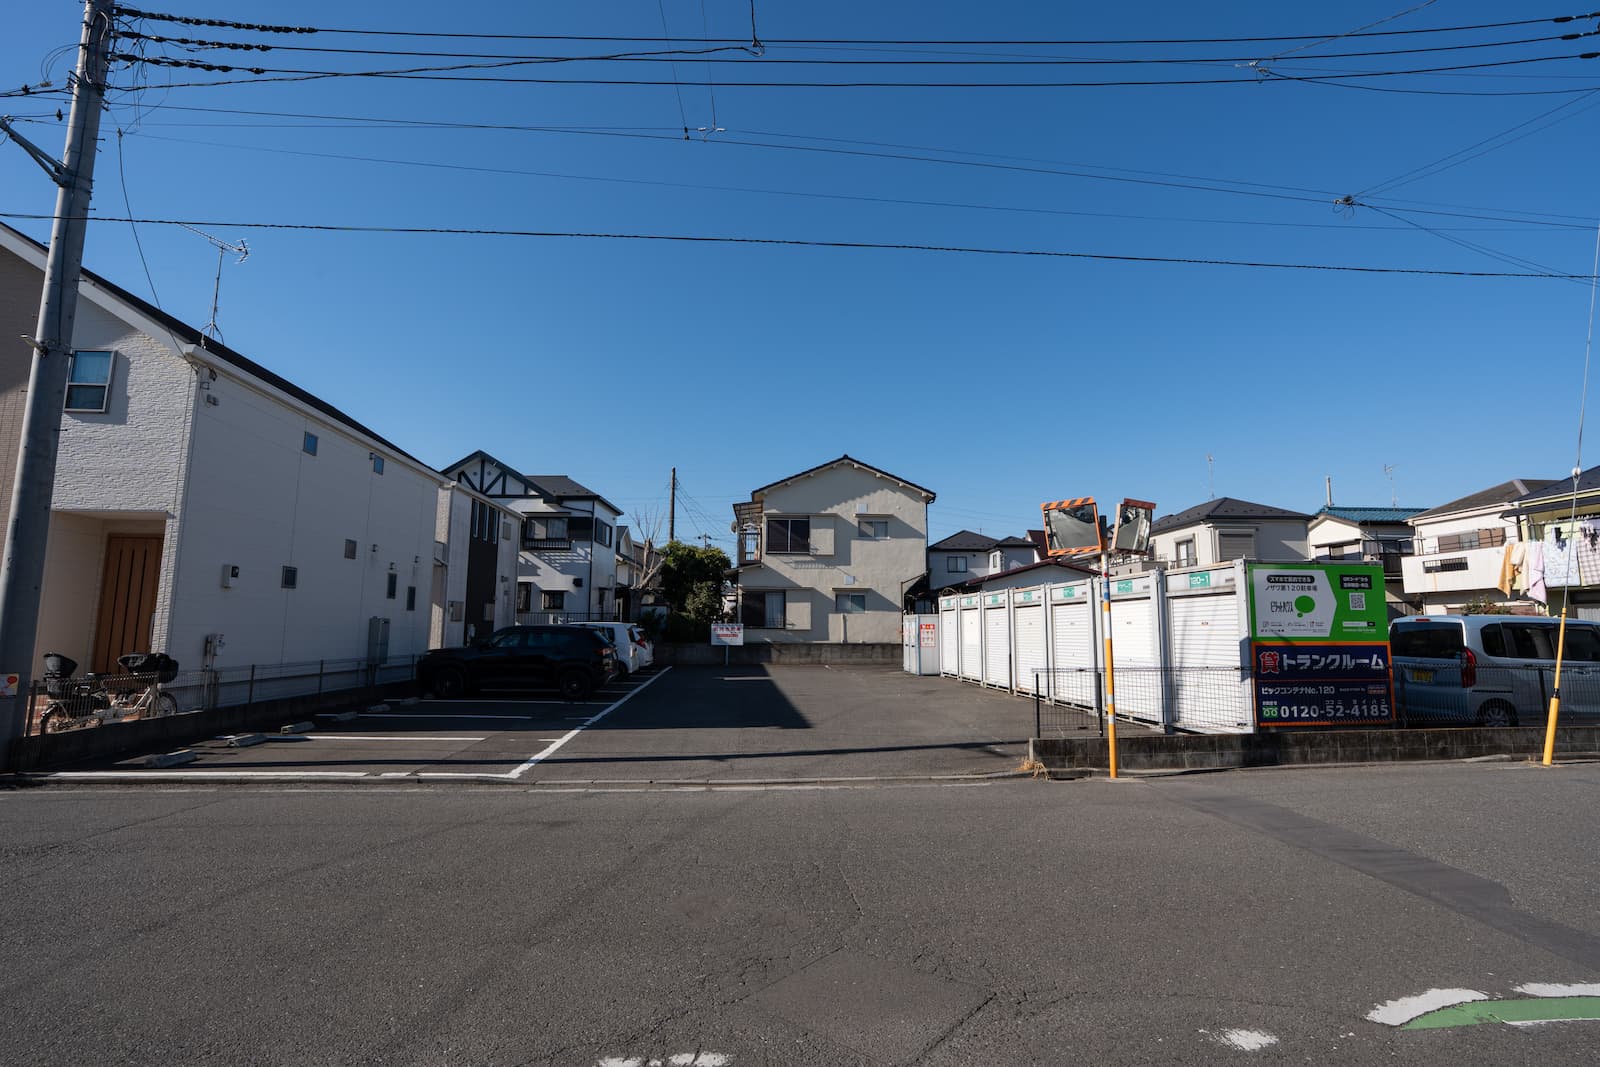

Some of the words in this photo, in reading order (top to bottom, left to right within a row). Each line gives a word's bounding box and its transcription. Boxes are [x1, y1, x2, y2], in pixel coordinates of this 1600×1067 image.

[1282, 654, 1384, 670] トランクルーム
[1280, 705, 1389, 717] 0120-52-4185
